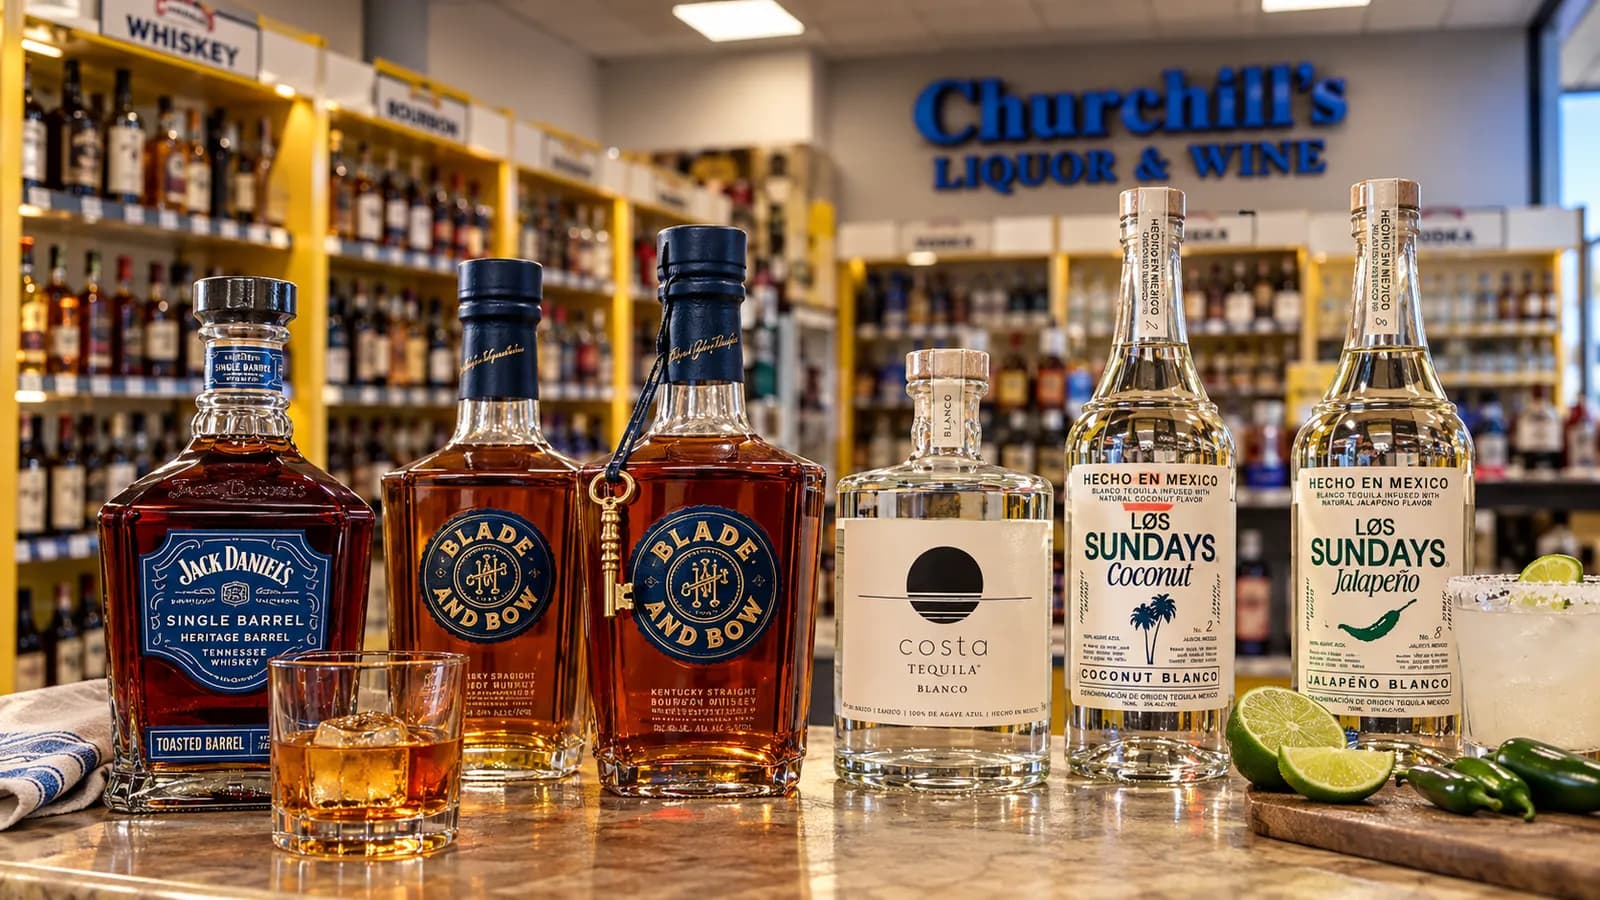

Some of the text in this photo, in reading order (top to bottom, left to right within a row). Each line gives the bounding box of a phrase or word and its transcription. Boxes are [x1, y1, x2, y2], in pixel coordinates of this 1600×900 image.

[126, 14, 240, 66] WHISKEY
[914, 62, 1348, 145] Churchill's
[934, 139, 1327, 194] LIQUOR & WINE
[944, 394, 952, 437] BLANCO
[1084, 473, 1218, 487] HECHO EN MEXICO
[1309, 477, 1449, 489] HECHO EN MEXICO
[1131, 512, 1170, 530] LØS
[1355, 518, 1395, 536] LØS
[440, 522, 534, 558] BLADE
[650, 521, 759, 564] BLADE
[1085, 531, 1216, 562] SUNDAYS
[1311, 537, 1446, 567] SUNDAYS
[178, 545, 295, 588] JACK DANIEL'S
[1107, 562, 1194, 587] Coconut
[1332, 568, 1420, 598] Jalapeño
[432, 585, 538, 630] AND BOW
[166, 615, 305, 626] SINGLE BARREL
[644, 595, 763, 649] AND BOW
[1206, 619, 1213, 632] 2
[180, 633, 290, 642] HERITAGE BARREL
[1434, 626, 1442, 639] 8
[202, 648, 267, 657] TENNESSEE
[899, 635, 988, 656] costa
[211, 658, 260, 667] WHISKEY
[1081, 668, 1218, 683] COCONUT BLANCO
[1389, 678, 1450, 690] BLANCO
[651, 688, 757, 696] KENTUCKY STRAIGHT
[917, 684, 968, 693] BLANCO
[156, 737, 202, 751] TOASTED
[205, 736, 245, 751] BARREL
